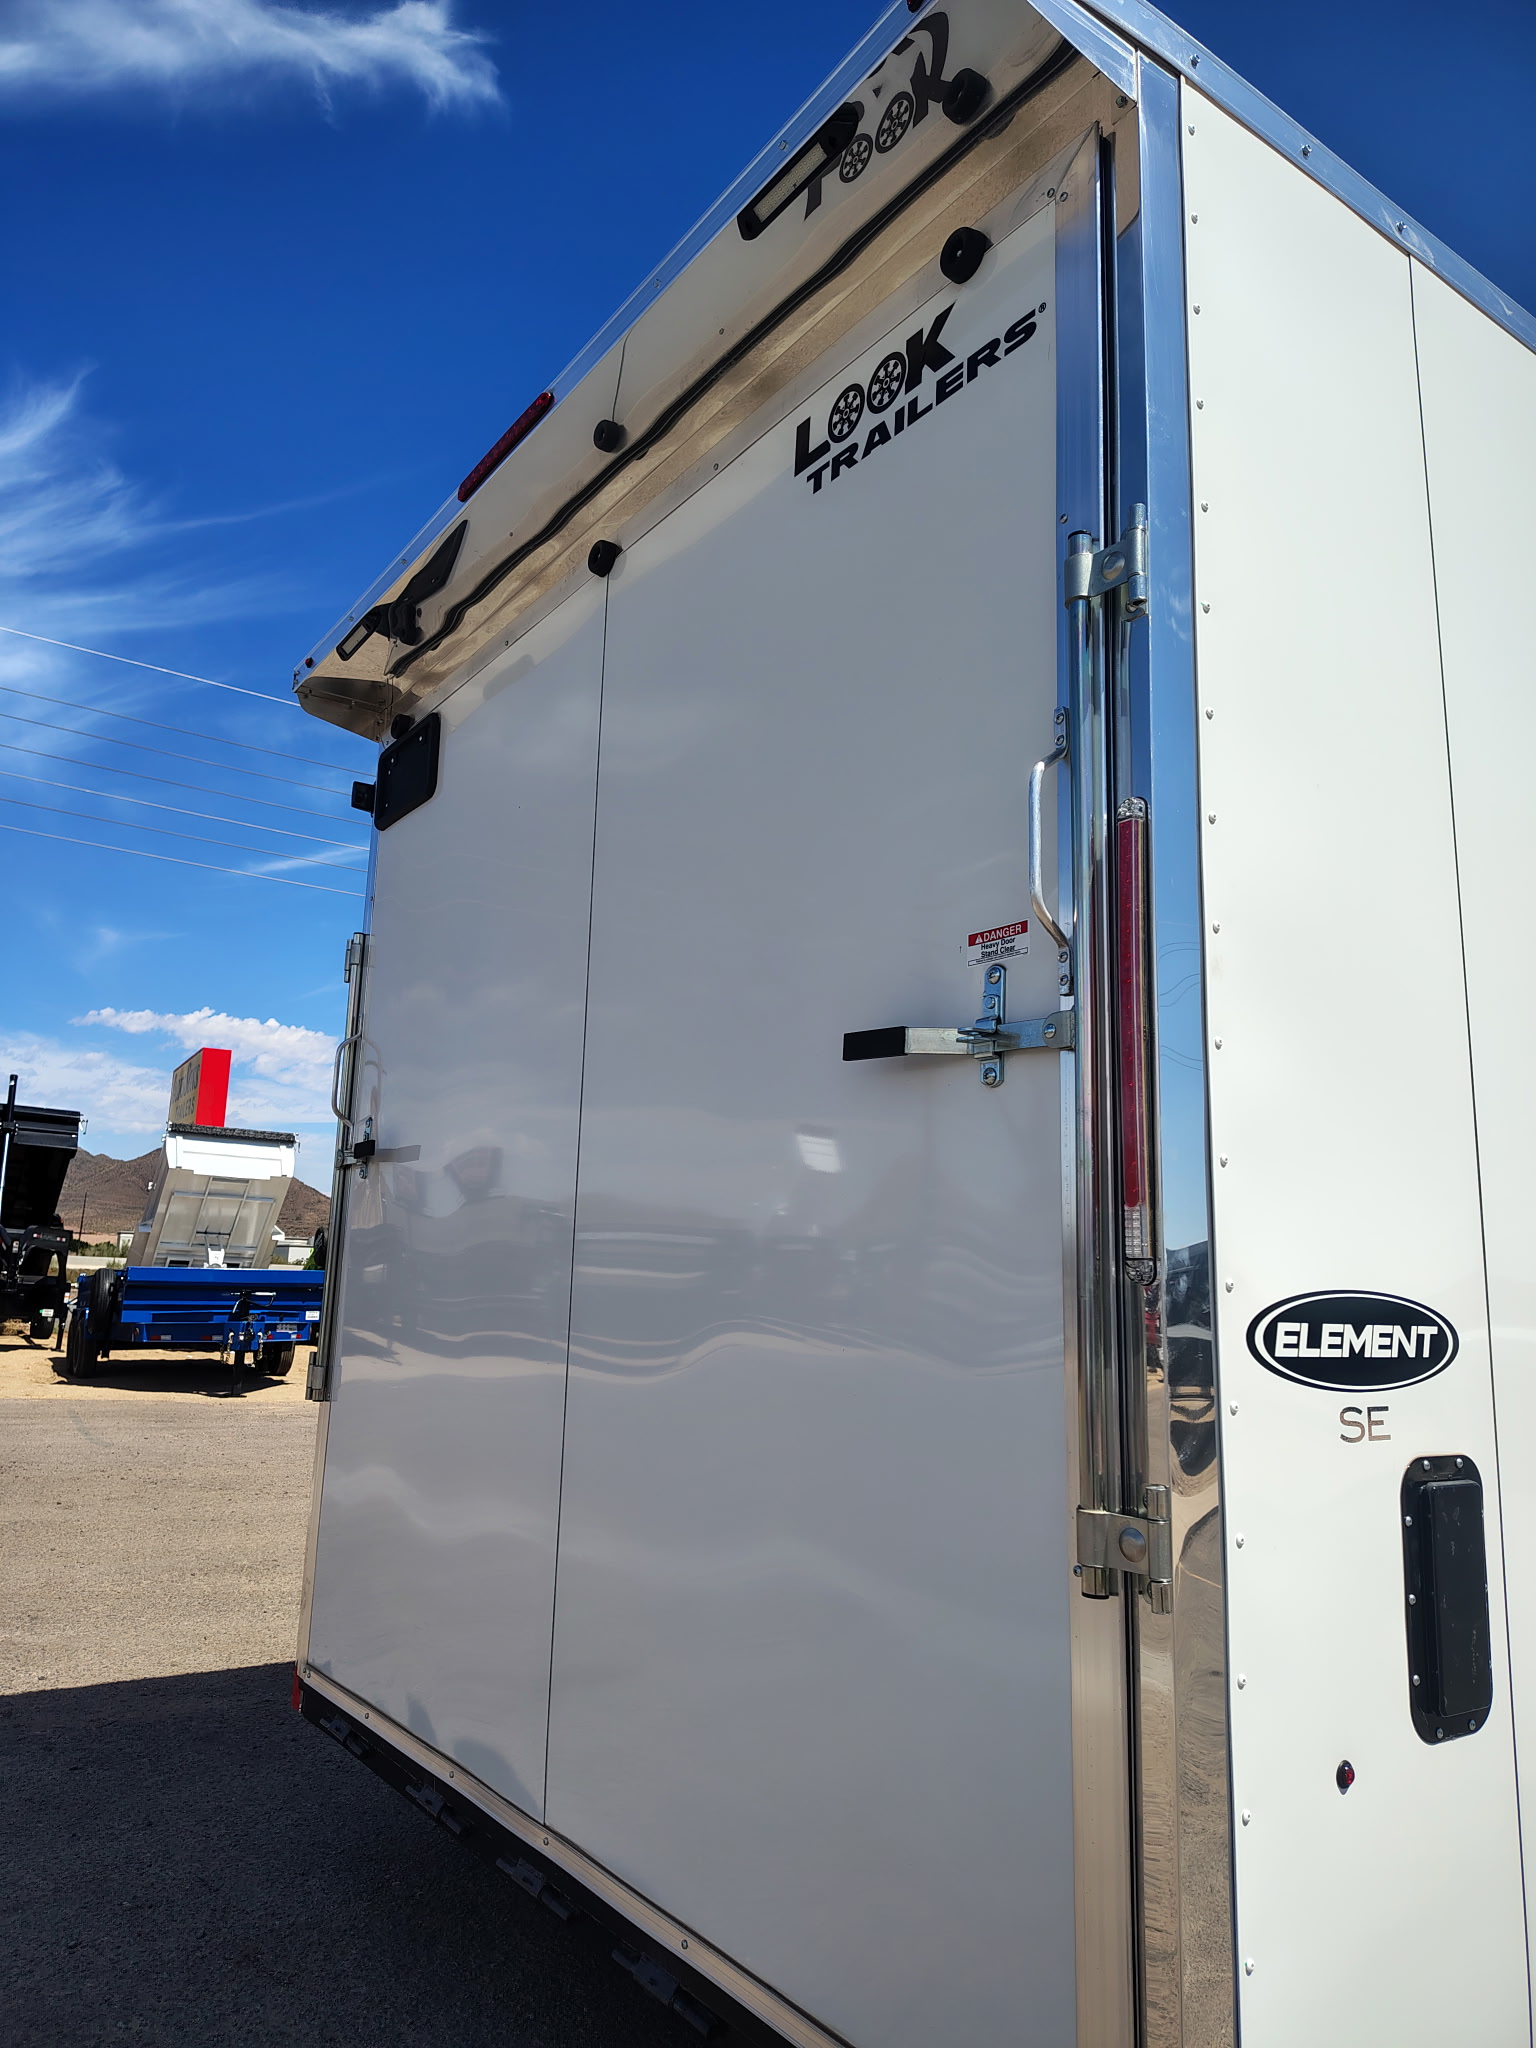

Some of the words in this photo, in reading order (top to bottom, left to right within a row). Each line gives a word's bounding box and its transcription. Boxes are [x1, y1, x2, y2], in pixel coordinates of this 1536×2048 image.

[794, 302, 956, 478] LOOK
[981, 941, 1000, 950] Heavy
[1001, 937, 1016, 946] Door
[983, 924, 1022, 942] DANGER
[981, 946, 998, 958] Stand
[1000, 945, 1016, 954] Clear
[1274, 1322, 1439, 1358] ELEMENT
[1339, 1406, 1392, 1444] SE
